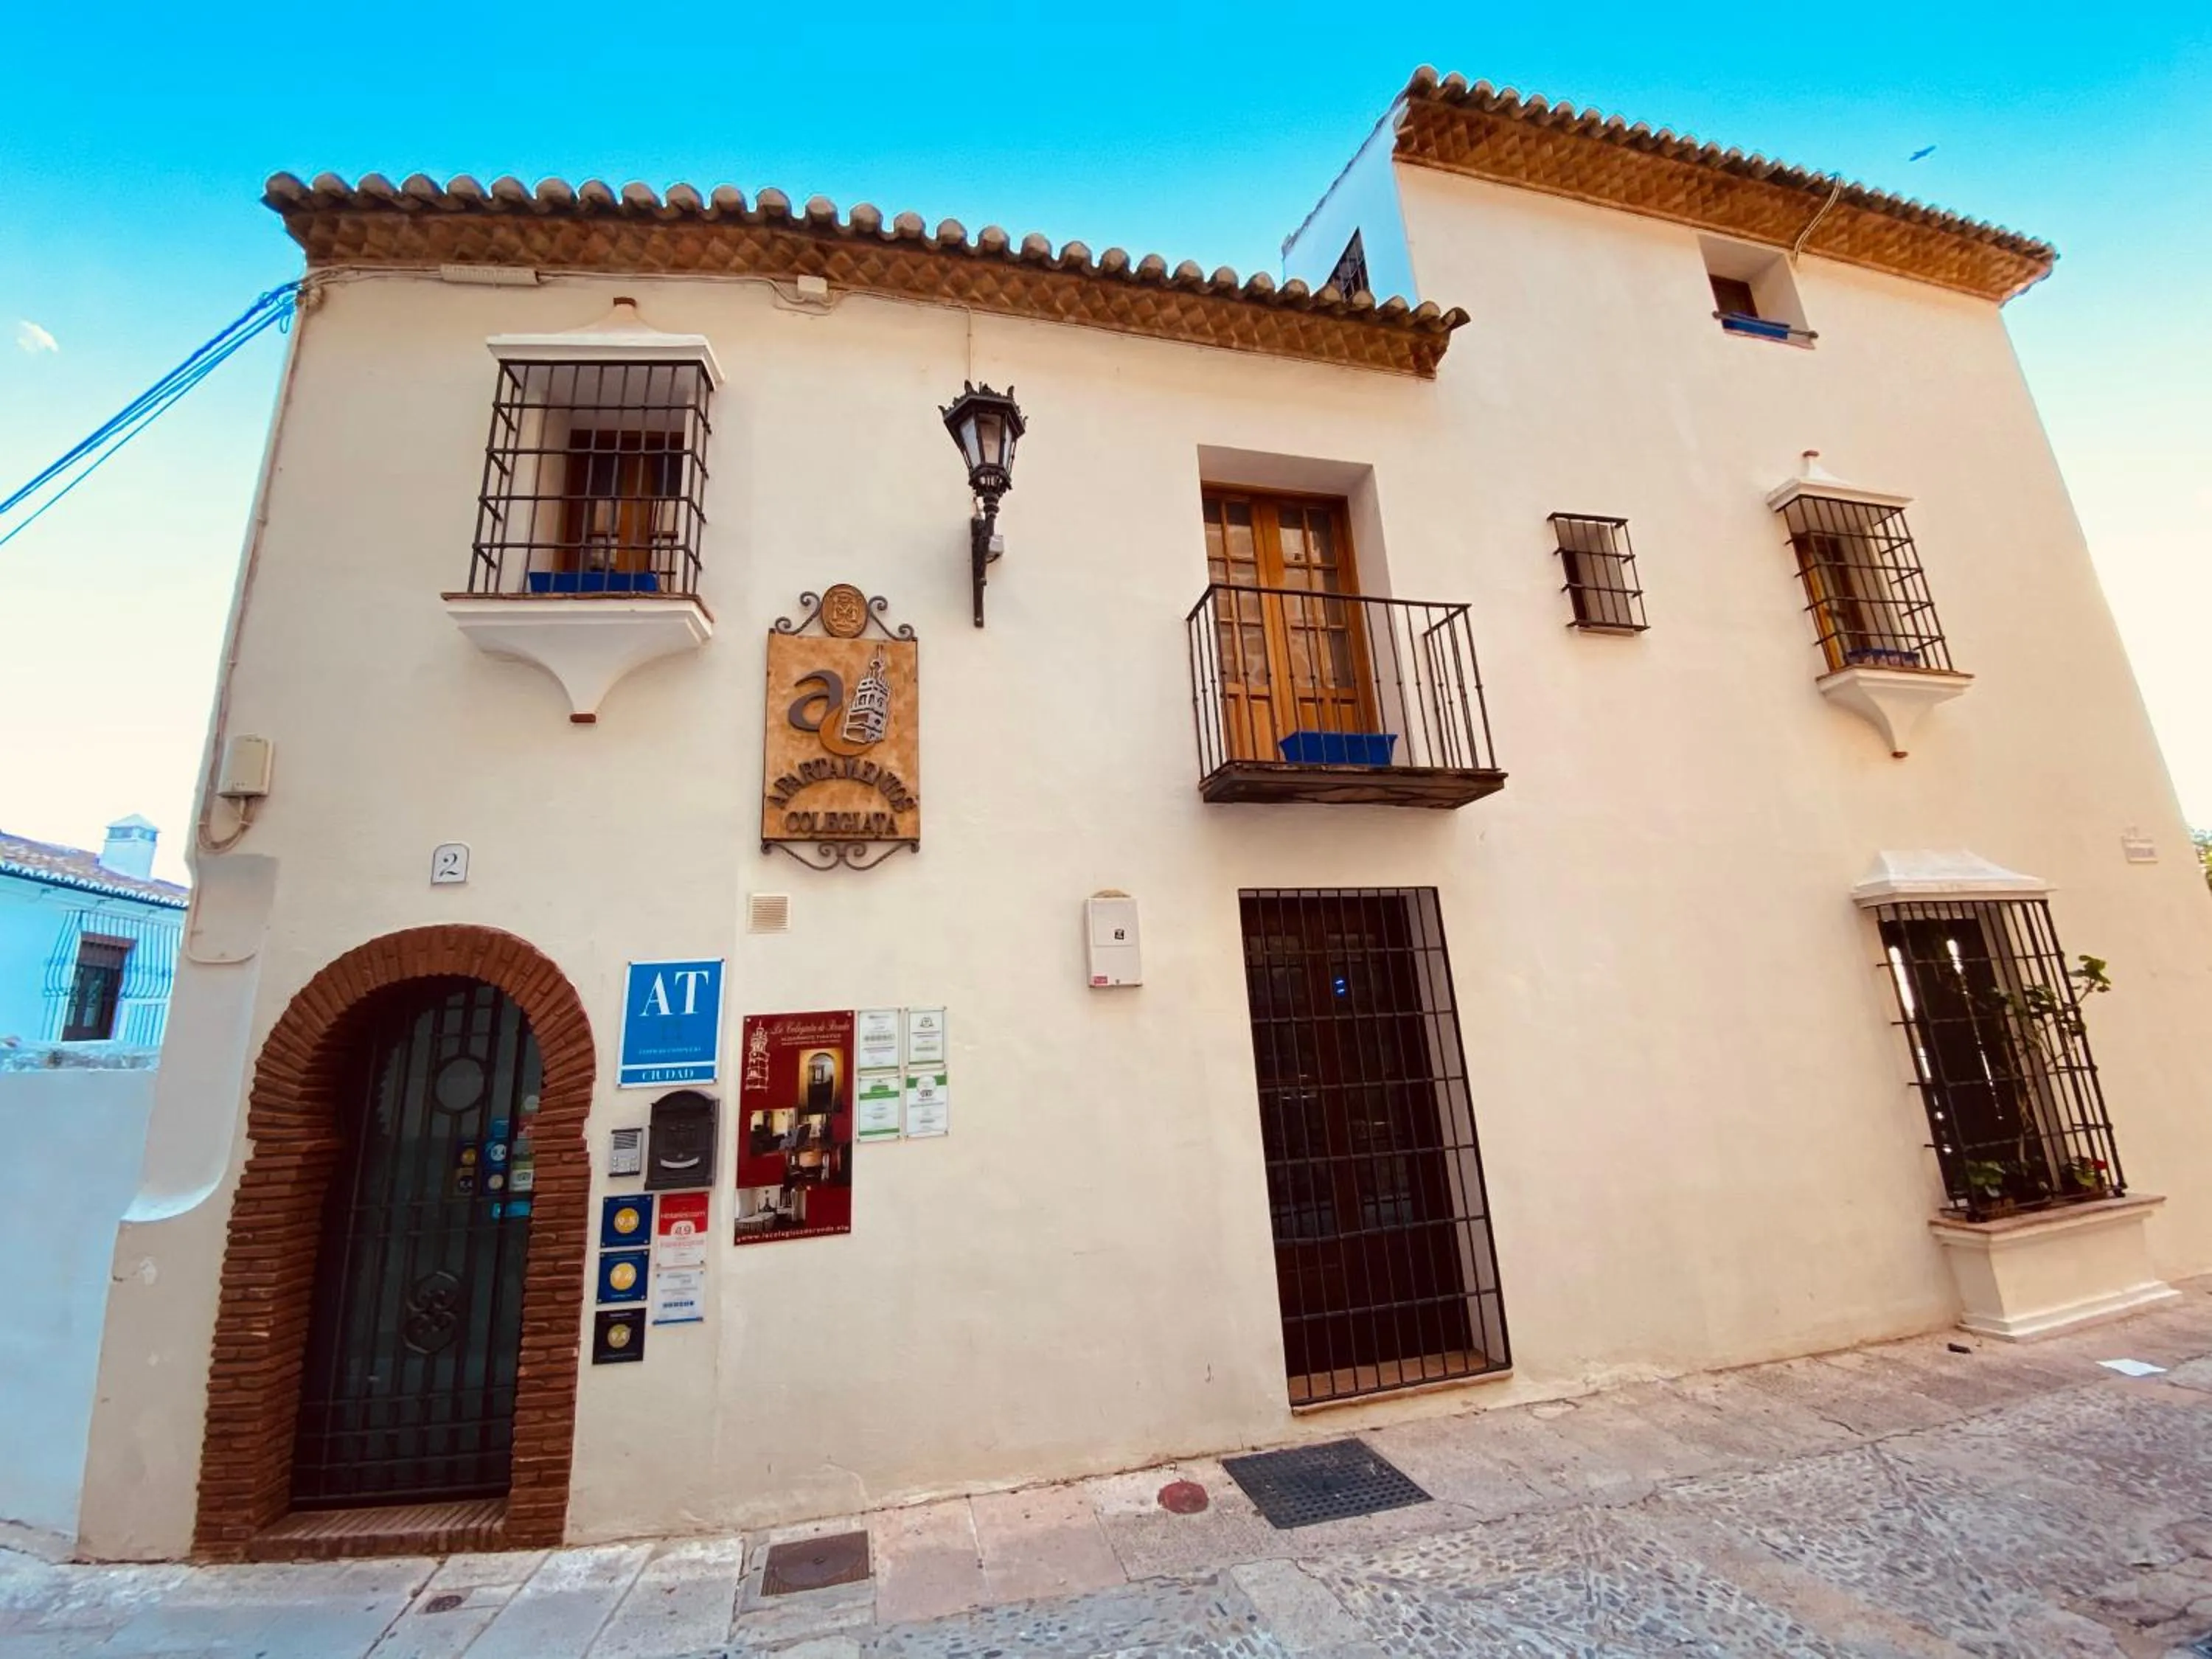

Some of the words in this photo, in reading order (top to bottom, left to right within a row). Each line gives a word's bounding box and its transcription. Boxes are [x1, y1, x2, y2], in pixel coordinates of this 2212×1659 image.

[767, 757, 917, 813] APARTAMENTOS
[785, 811, 899, 835] COLEGIATA
[439, 852, 460, 877] 2
[639, 970, 709, 1017] AT
[641, 1068, 695, 1081] CIUDAD
